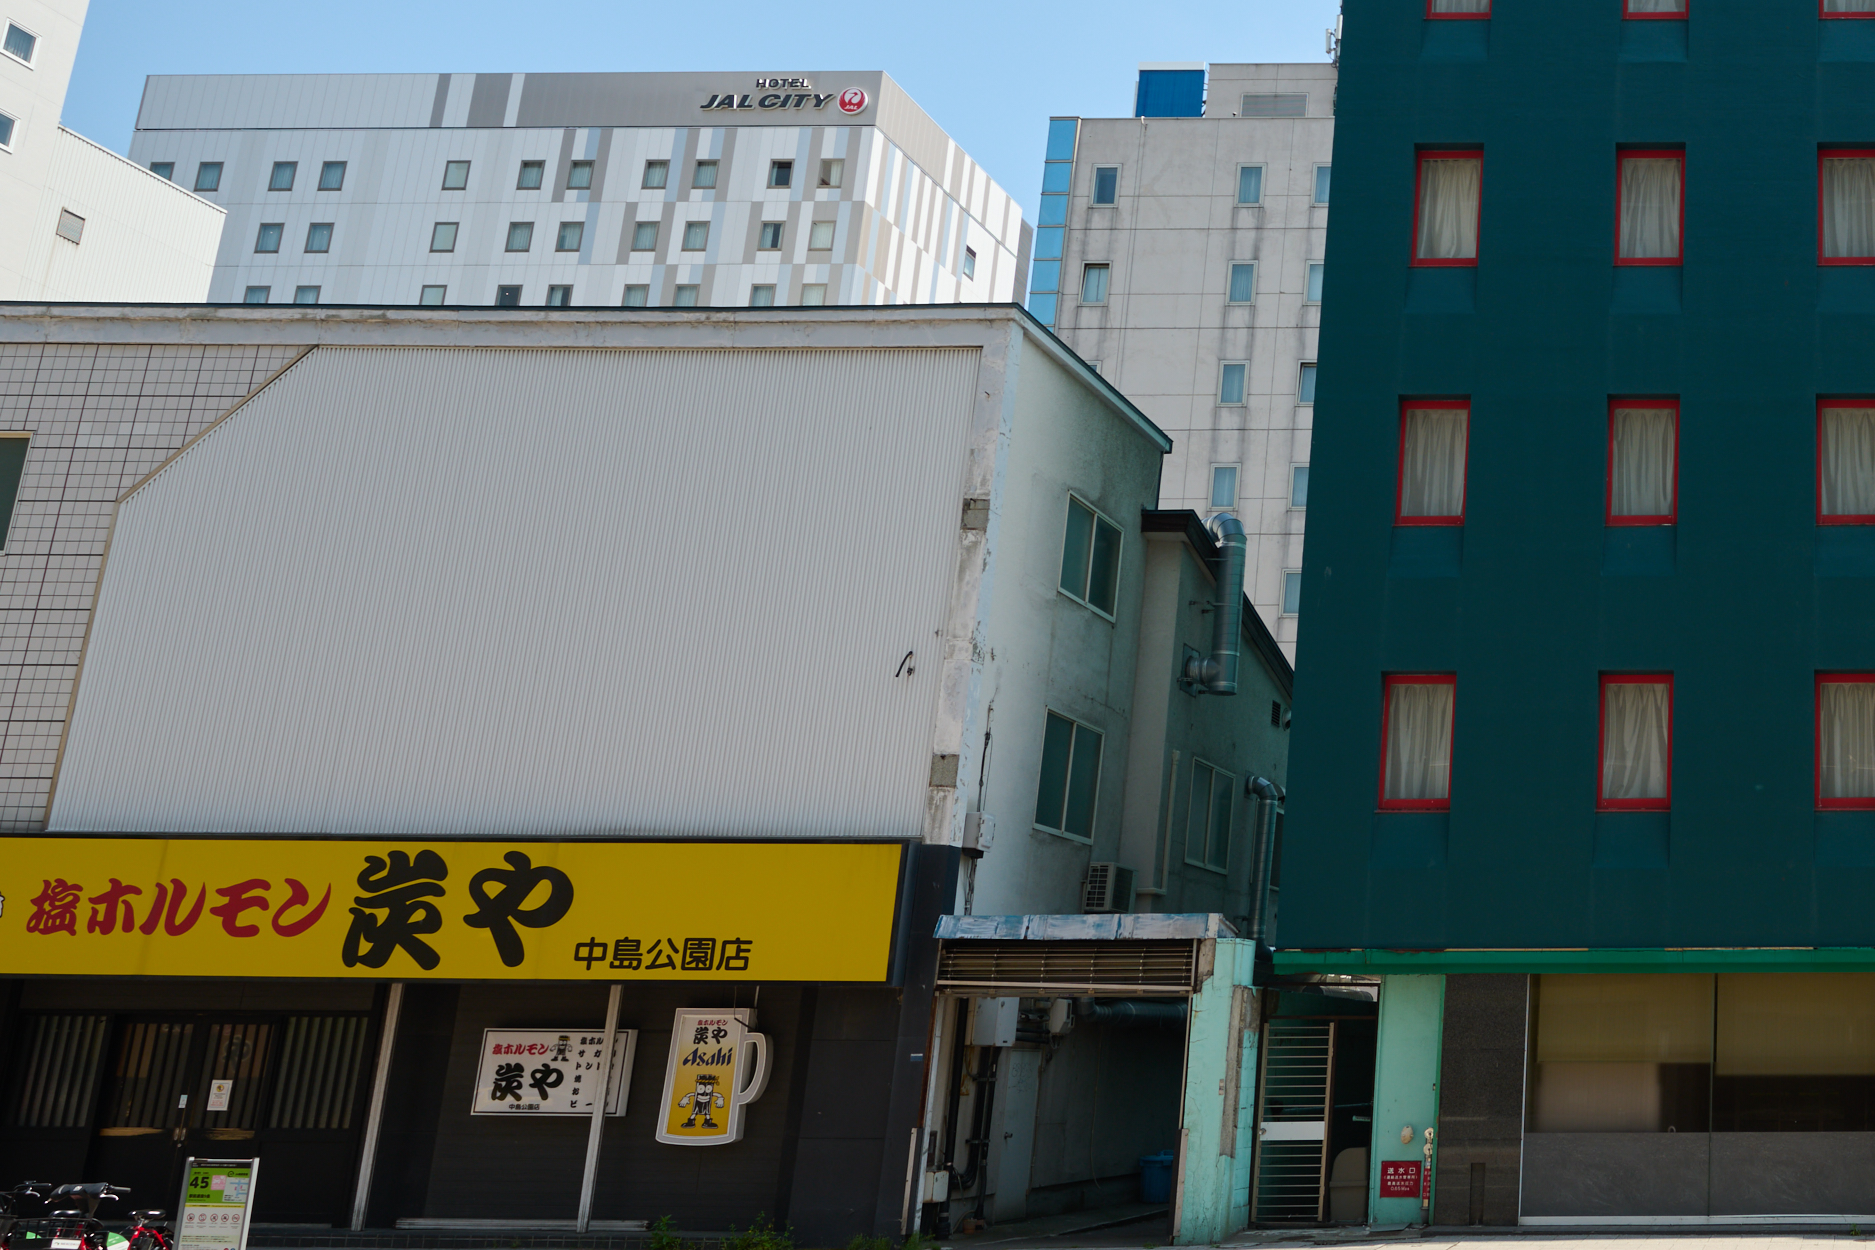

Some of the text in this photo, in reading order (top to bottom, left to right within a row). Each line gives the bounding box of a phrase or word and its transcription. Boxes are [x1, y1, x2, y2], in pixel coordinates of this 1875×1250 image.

[756, 78, 811, 89] HOTEL
[700, 93, 835, 109] JAL CITY
[26, 876, 331, 938] 塩ホルモン
[342, 849, 574, 970] 炭や
[574, 936, 753, 972] 中島公園店
[693, 1027, 728, 1045] 炭や
[492, 1044, 549, 1055] 塩ホルモン
[683, 1047, 733, 1066] Asahi
[491, 1063, 564, 1102] 炭や
[190, 1176, 209, 1188] 45
